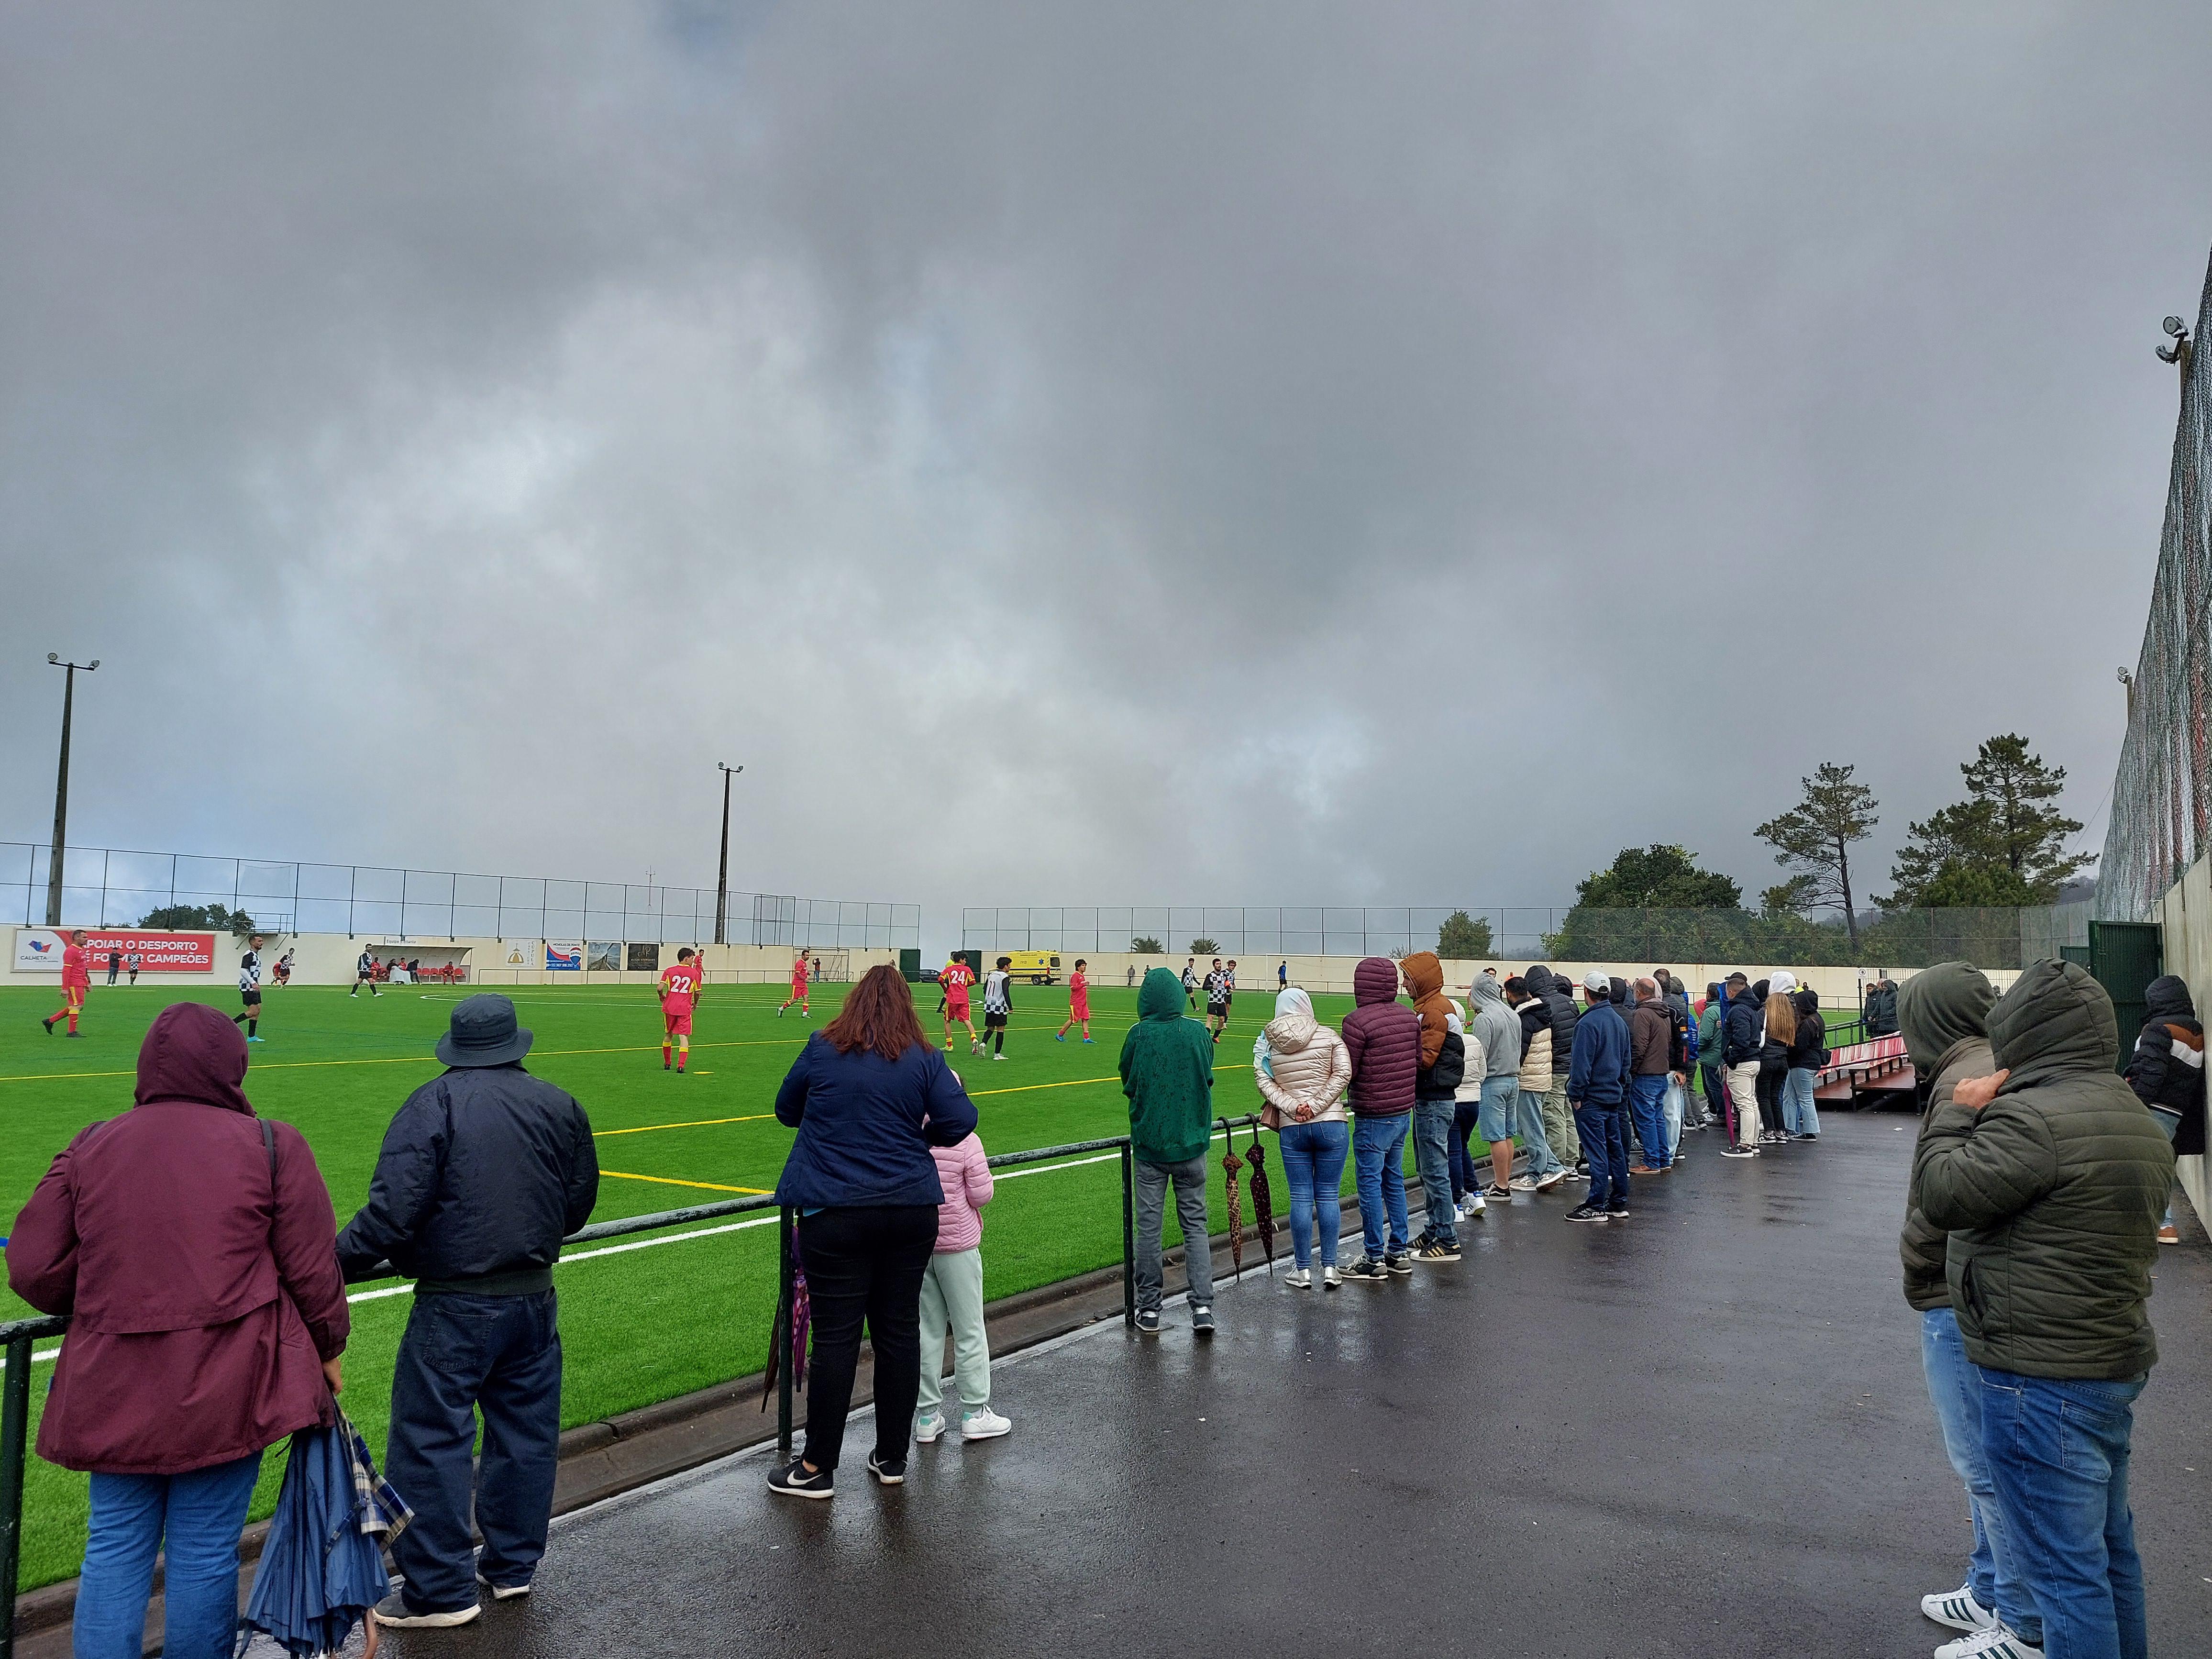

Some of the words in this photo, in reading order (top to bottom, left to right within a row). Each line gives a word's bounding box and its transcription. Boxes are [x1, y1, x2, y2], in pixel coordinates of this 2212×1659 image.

[84, 939, 122, 949] POIAR
[126, 940, 135, 949] O
[138, 940, 198, 951] DESPORTO
[93, 953, 144, 963] FOMR
[146, 952, 209, 964] CAMPEÕES
[670, 975, 690, 994] 22
[951, 970, 965, 985] 24
[988, 980, 995, 997] 11
